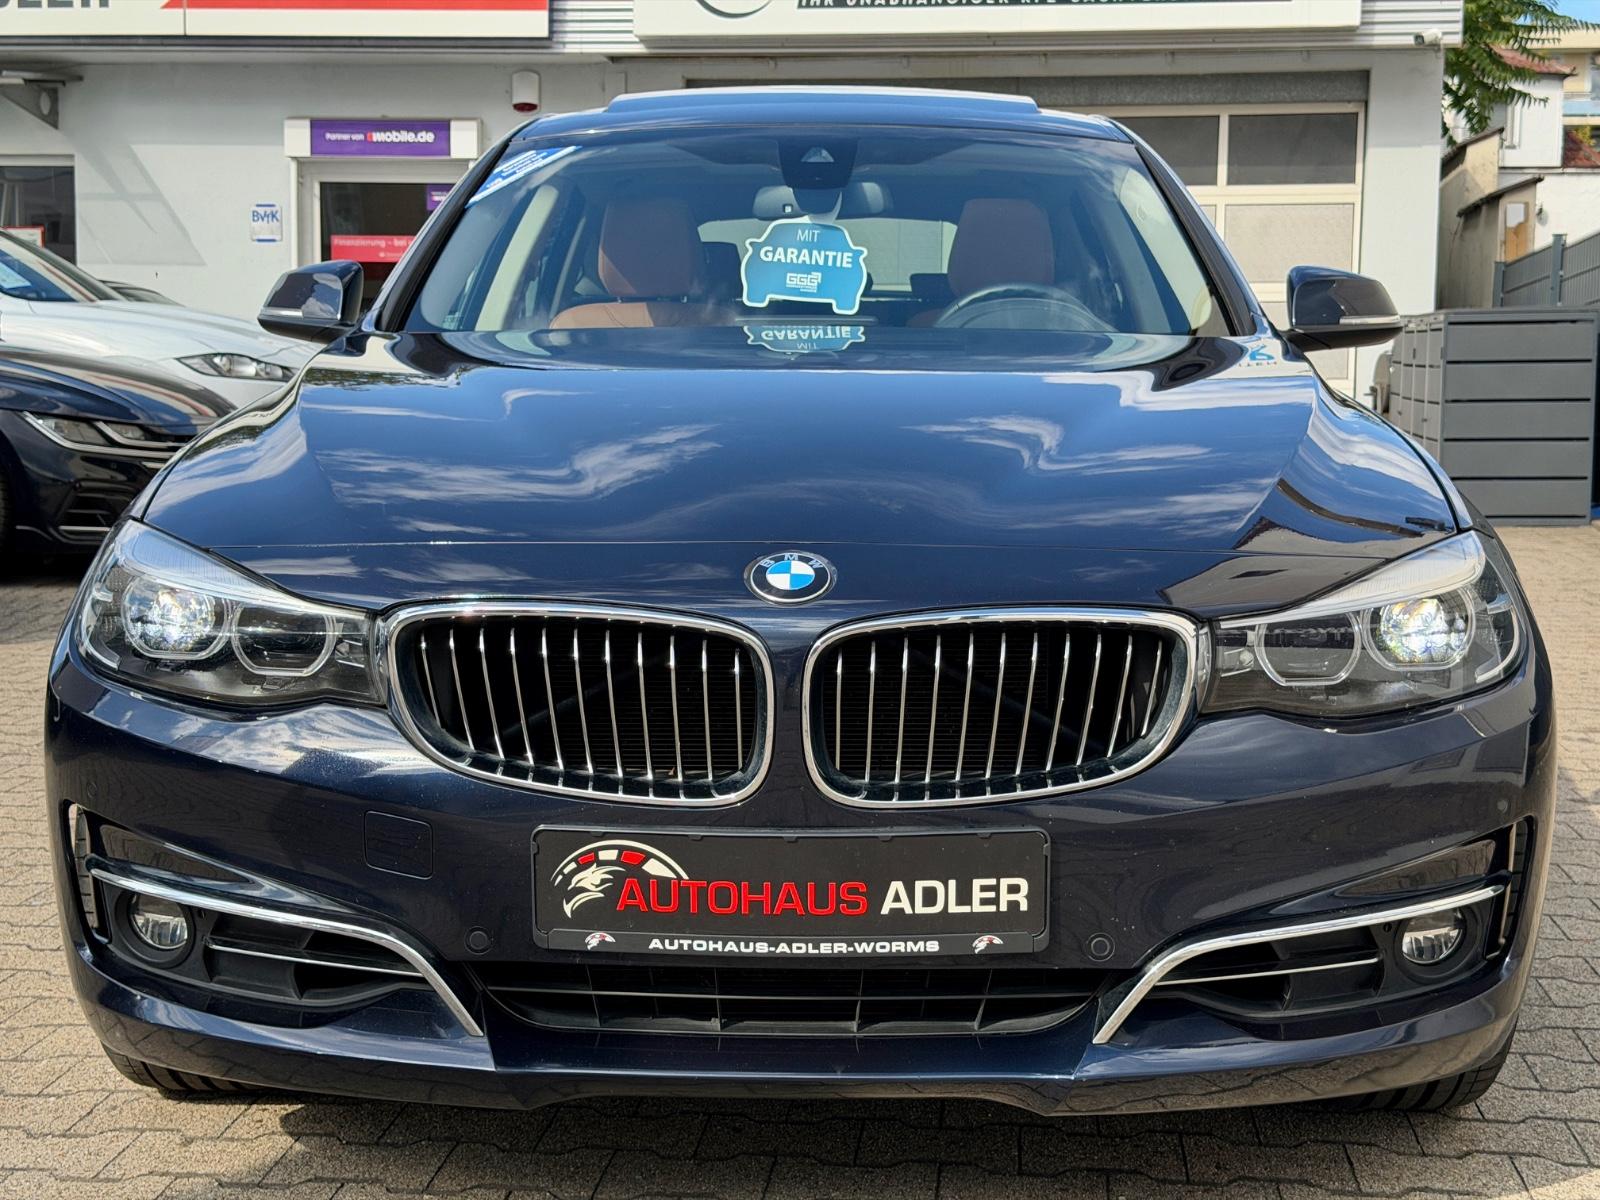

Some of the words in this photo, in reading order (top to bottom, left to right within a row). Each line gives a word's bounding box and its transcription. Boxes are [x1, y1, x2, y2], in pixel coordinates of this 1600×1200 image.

[371, 130, 435, 143] mobile.de
[796, 229, 820, 242] MIT
[759, 246, 853, 268] GARANTIE
[759, 552, 824, 569] BMW
[616, 878, 869, 916] AUTOHAUS
[880, 877, 1029, 915] ADLER
[648, 938, 940, 954] AUTOHAUS-ADLER-WORMS
